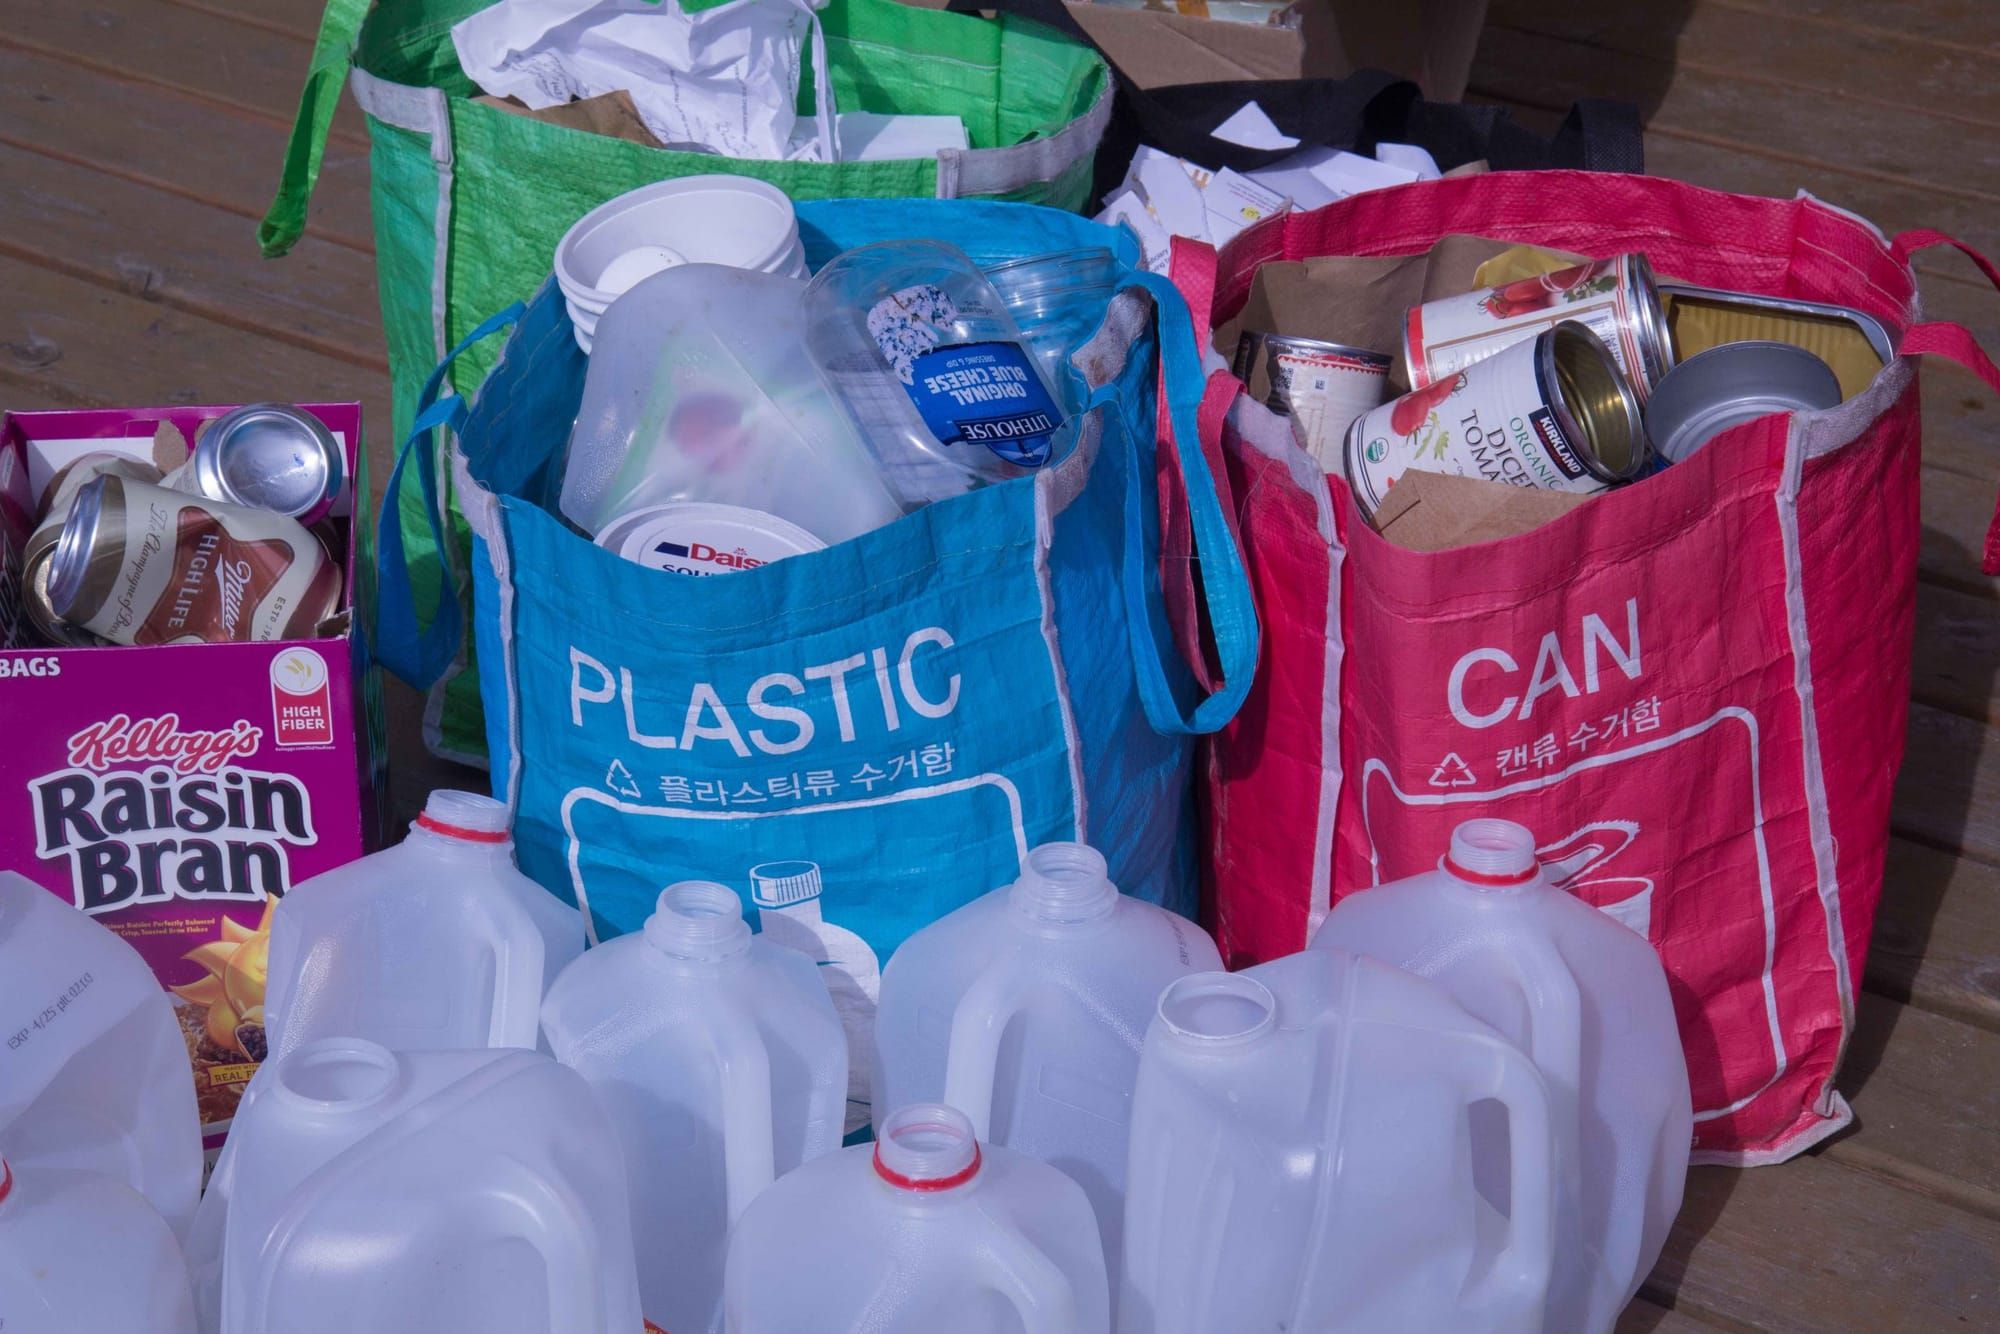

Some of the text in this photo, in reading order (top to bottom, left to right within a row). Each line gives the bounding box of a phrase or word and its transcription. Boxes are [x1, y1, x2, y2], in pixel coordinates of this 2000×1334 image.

[924, 366, 1028, 395] BLUE CHEESE
[949, 381, 1027, 406] ORIGINAL
[960, 414, 1053, 440] LITEHOUSE
[1509, 416, 1563, 490] ORGANIC
[1539, 415, 1582, 474] KIRKLAND
[167, 534, 219, 629] HIGH LIFE
[690, 543, 769, 570] Dais
[224, 559, 252, 640] Miller
[0, 657, 61, 678] BAGS
[569, 626, 961, 758] PLASTIC
[1447, 597, 1642, 729] CAN
[281, 718, 326, 731] FIBER
[282, 705, 322, 718] HIGH
[1496, 695, 1662, 777] 캔류 수거함
[69, 714, 261, 774] Kellogg's
[658, 742, 956, 806] 플라스틱류 수거함
[33, 769, 313, 853] Raisin
[75, 838, 288, 911] Bran
[185, 917, 216, 926] Balanced
[214, 1071, 243, 1083] REAL
